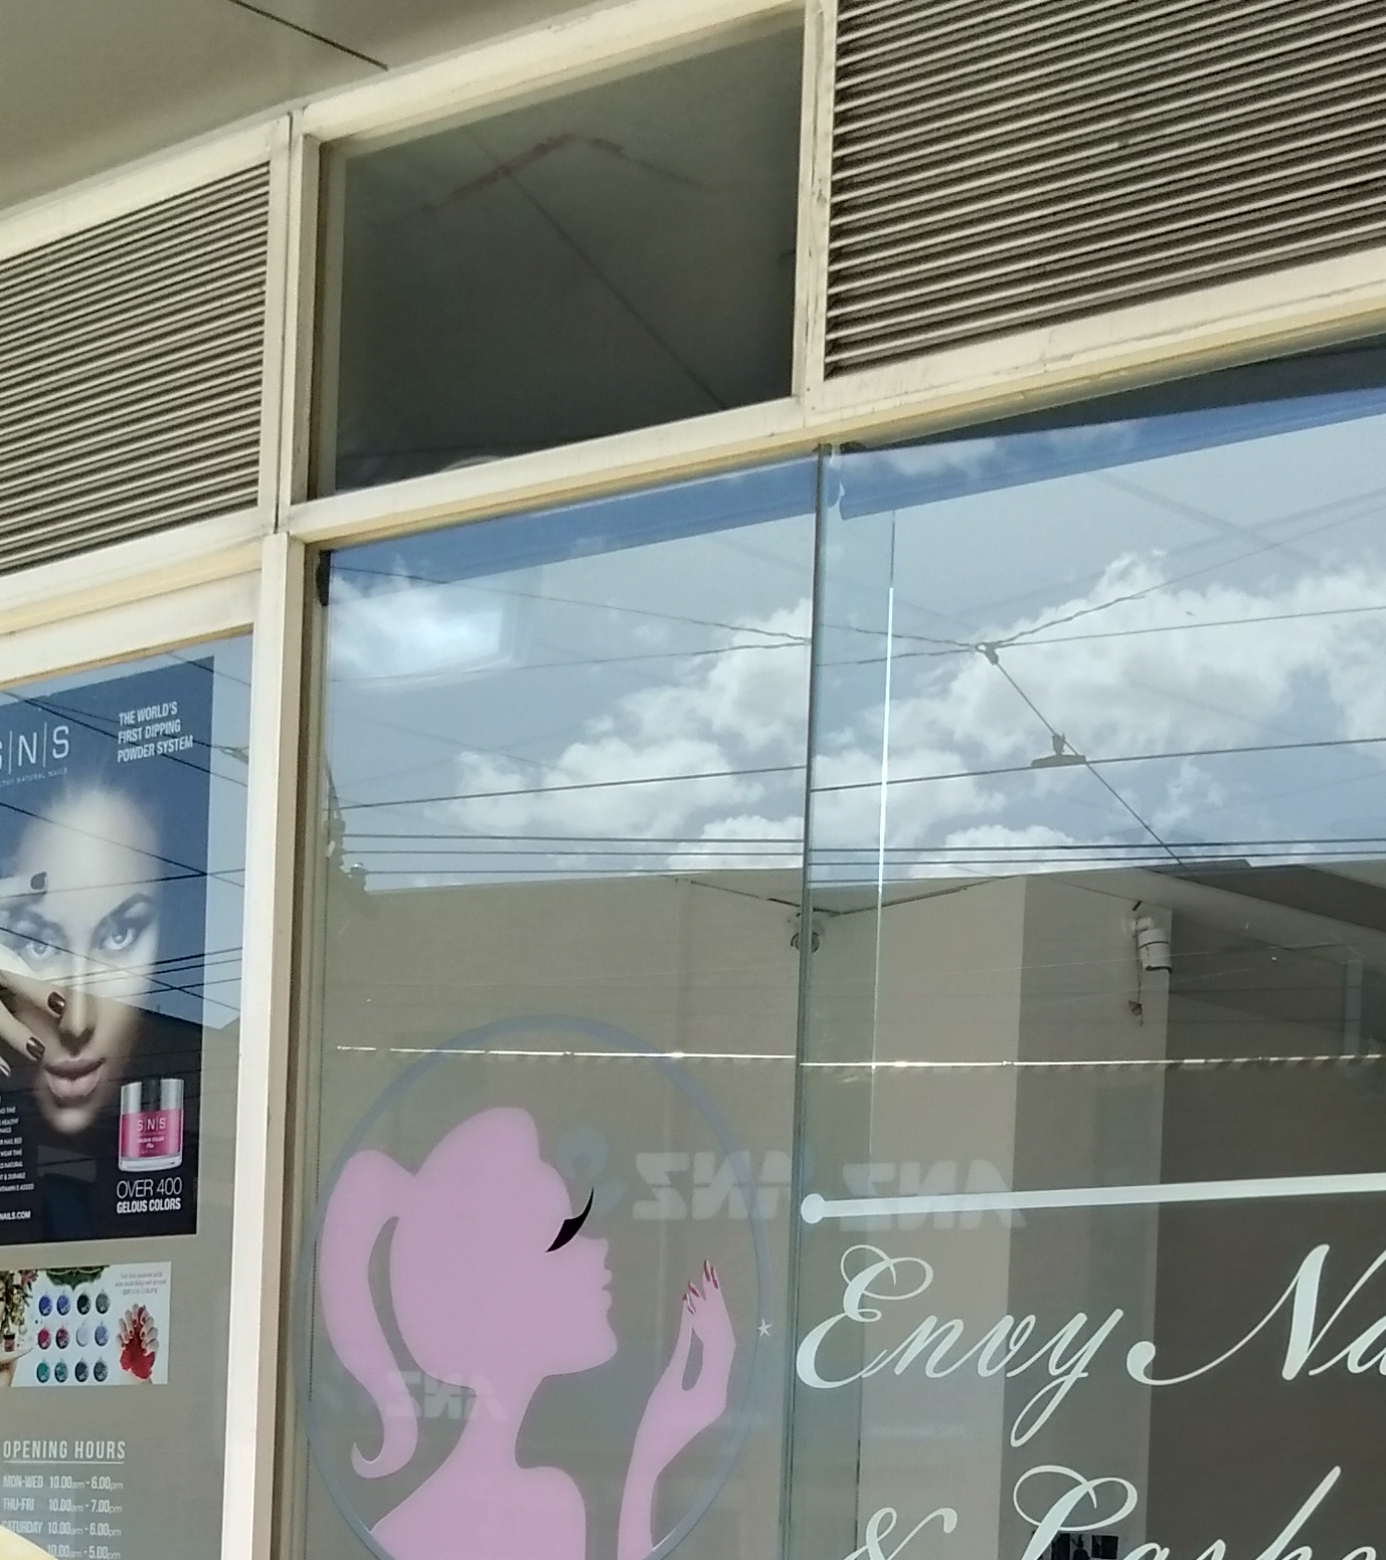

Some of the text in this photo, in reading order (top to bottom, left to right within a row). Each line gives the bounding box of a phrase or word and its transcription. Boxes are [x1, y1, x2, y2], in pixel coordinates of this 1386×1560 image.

[118, 701, 178, 726] THE WORLD'S
[117, 719, 181, 744] FIRST DIPPING
[117, 735, 194, 764] POWDER SYSTEM
[116, 1177, 183, 1199] OVER 400
[116, 1197, 182, 1214] GELOUS COLORS
[796, 1244, 1124, 1447] Envy
[3, 1440, 126, 1459] OPENING HOURS
[3, 1475, 44, 1489] MON-WED
[2, 1497, 35, 1511] THU-FRI
